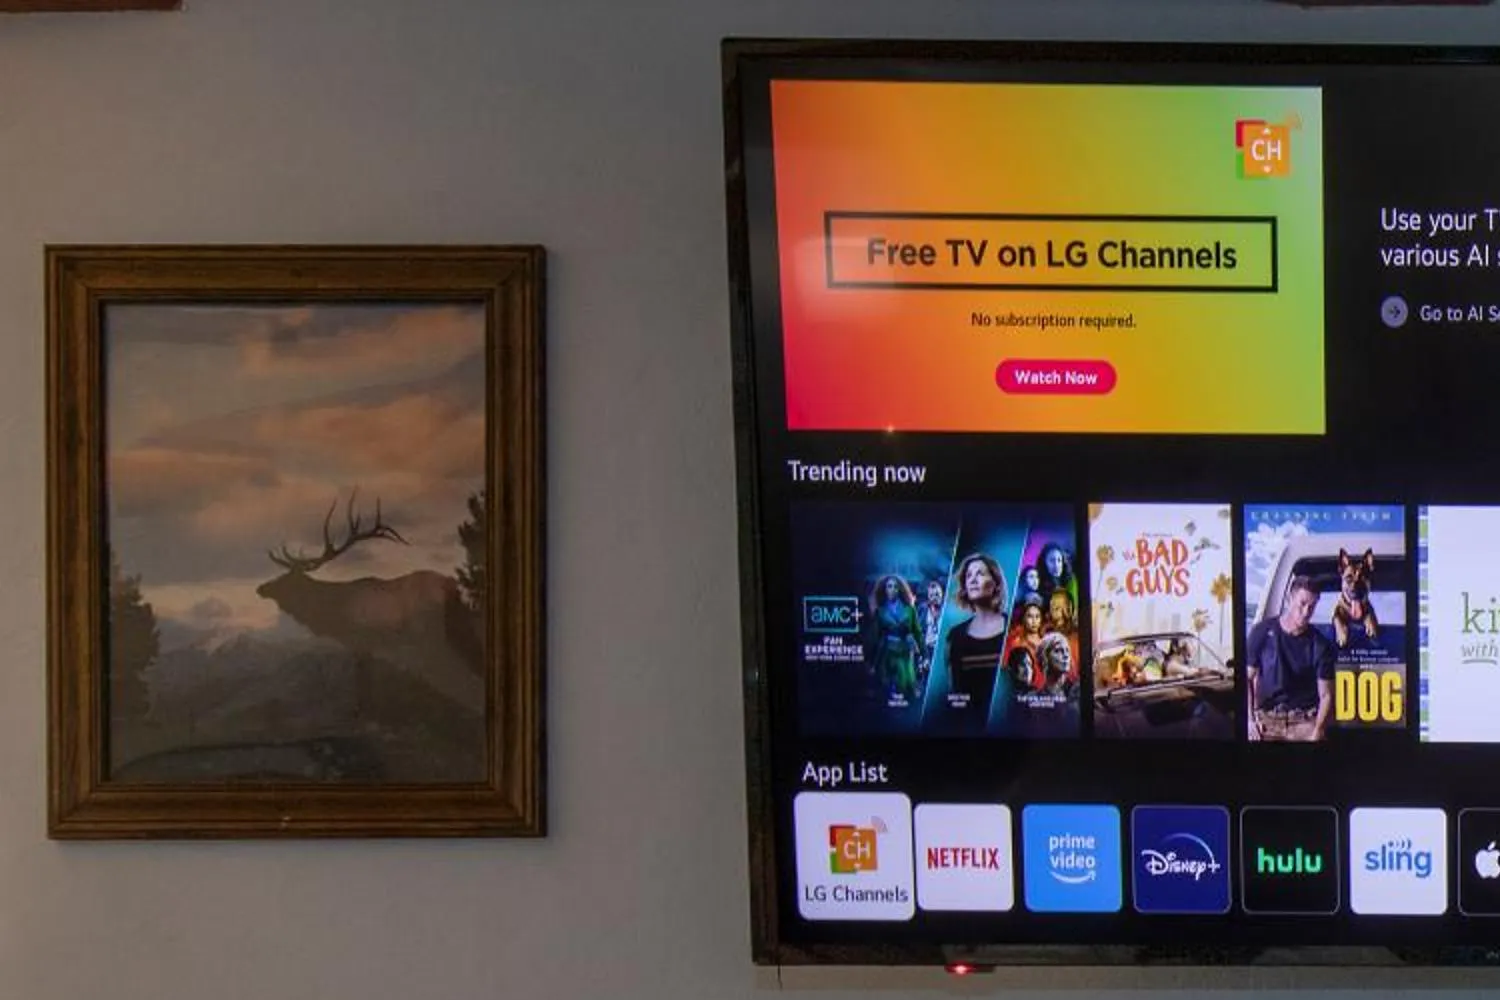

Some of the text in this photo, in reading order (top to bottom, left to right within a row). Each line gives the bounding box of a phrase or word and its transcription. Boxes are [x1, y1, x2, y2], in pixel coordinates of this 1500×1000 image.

[1251, 139, 1282, 163] CH
[1380, 208, 1422, 232] Use
[1429, 212, 1476, 237] your
[867, 238, 1237, 270] Free TV on LG Channels
[1381, 245, 1459, 268] various
[1467, 244, 1490, 268] AI
[971, 313, 1136, 331] No subscription required.
[1420, 306, 1442, 323] Go
[1447, 307, 1463, 323] to
[1467, 306, 1484, 322] AI
[1015, 370, 1098, 386] Watch Now
[788, 461, 926, 486] Trending now
[1135, 538, 1189, 567] BAD
[1125, 565, 1190, 597] GUYS
[1461, 639, 1499, 658] with
[1336, 671, 1403, 722] DOG
[803, 762, 889, 787] App List
[843, 840, 872, 861] CH
[1049, 833, 1095, 852] prime
[927, 847, 999, 871] NETFLIX
[1050, 853, 1096, 869] video
[1257, 847, 1322, 873] hulu
[1365, 843, 1432, 878] sling
[805, 885, 909, 903] LG Channels
